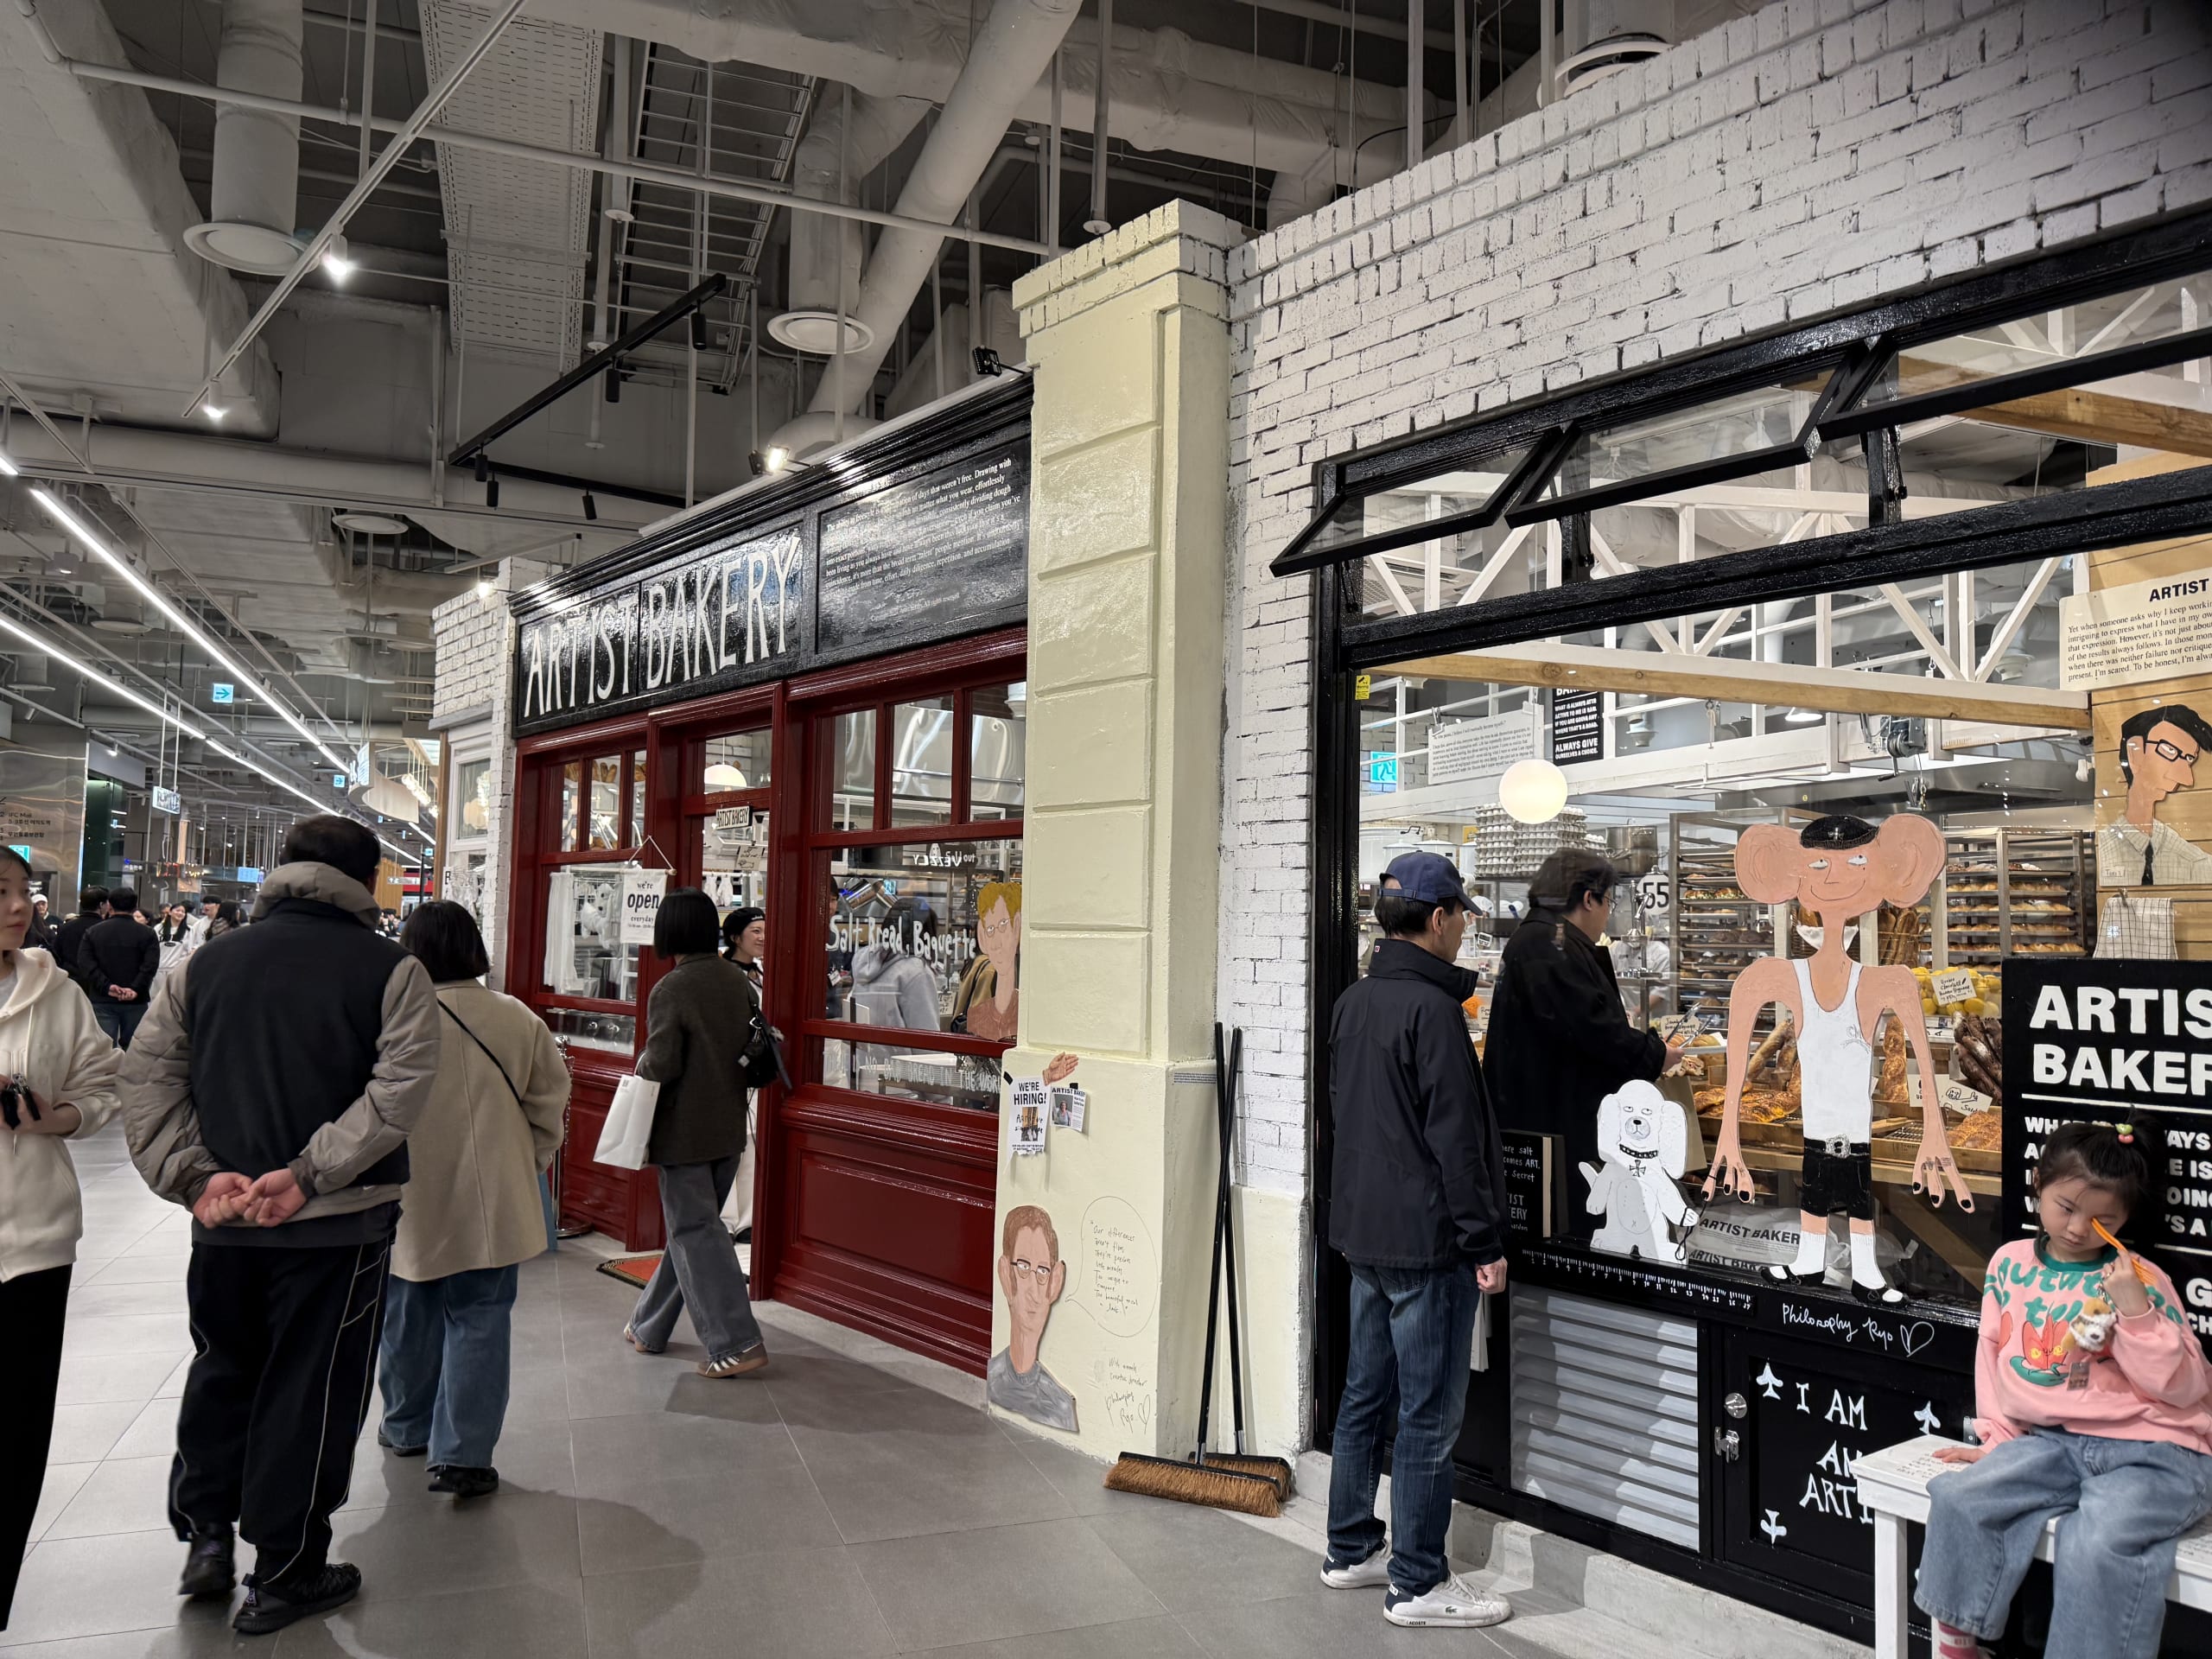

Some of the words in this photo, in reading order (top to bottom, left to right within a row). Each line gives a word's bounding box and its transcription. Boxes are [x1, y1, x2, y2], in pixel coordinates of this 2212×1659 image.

[962, 474, 974, 483] free.
[975, 465, 997, 478] Drawing
[999, 458, 1011, 468] with
[975, 474, 1005, 491] effortlessly
[971, 492, 993, 505] dividing
[994, 484, 1011, 496] dough
[985, 501, 1000, 512] claim
[964, 548, 973, 556] and
[2150, 579, 2209, 601] ARTIST
[524, 594, 636, 717] ARTIST
[646, 536, 800, 690] BAKERY
[2068, 631, 2100, 643] intriguing
[2110, 626, 2134, 636] express
[2137, 622, 2152, 631] what
[2160, 617, 2177, 626] have
[2069, 626, 2079, 634] Yet
[2081, 623, 2098, 632] when
[2100, 616, 2128, 627] someone
[2130, 613, 2145, 622] asks
[2147, 610, 2161, 620] why
[2170, 607, 2186, 616] keep
[2068, 643, 2080, 652] that
[2082, 639, 2118, 652] expression.
[2120, 632, 2152, 644] However,
[2178, 626, 2191, 635] just
[2088, 649, 2109, 658] results
[2112, 645, 2133, 655] always
[2136, 641, 2162, 651] follows.
[2175, 635, 2193, 644] those
[2069, 672, 2093, 683] present.
[2108, 665, 2132, 675] scared.
[2155, 658, 2180, 668] honest,
[2182, 655, 2194, 664] I'm
[2087, 659, 2104, 668] there
[2120, 653, 2144, 663] neither
[2145, 650, 2168, 659] failure
[1555, 741, 1580, 753] ALWAYS
[1582, 738, 1598, 747] GIVE
[963, 853, 976, 862] out
[627, 893, 659, 912] open
[631, 915, 653, 924] everyday
[825, 912, 863, 953] Salt
[868, 916, 910, 958] Bread,
[913, 920, 976, 970] Baguette
[2029, 984, 2212, 1039] ARTIS
[958, 1070, 976, 1091] THE
[1019, 1082, 1039, 1091] WE'RE
[1014, 1093, 1046, 1105] HIRING!
[1519, 1146, 1533, 1156] salt
[1525, 1159, 1540, 1169] ART.
[1507, 1193, 1524, 1205] IST
[1509, 1206, 1528, 1220] ERY
[1700, 1217, 1751, 1238] ARTIST
[1751, 1230, 1801, 1245] BAKER
[1689, 1249, 1726, 1265] ARTIST
[1732, 1258, 1769, 1271] BAK
[1783, 1303, 1859, 1342] Philosophy
[1862, 1317, 1893, 1350] Ryo
[1796, 1382, 1810, 1414] I
[1824, 1389, 1868, 1431] AM
